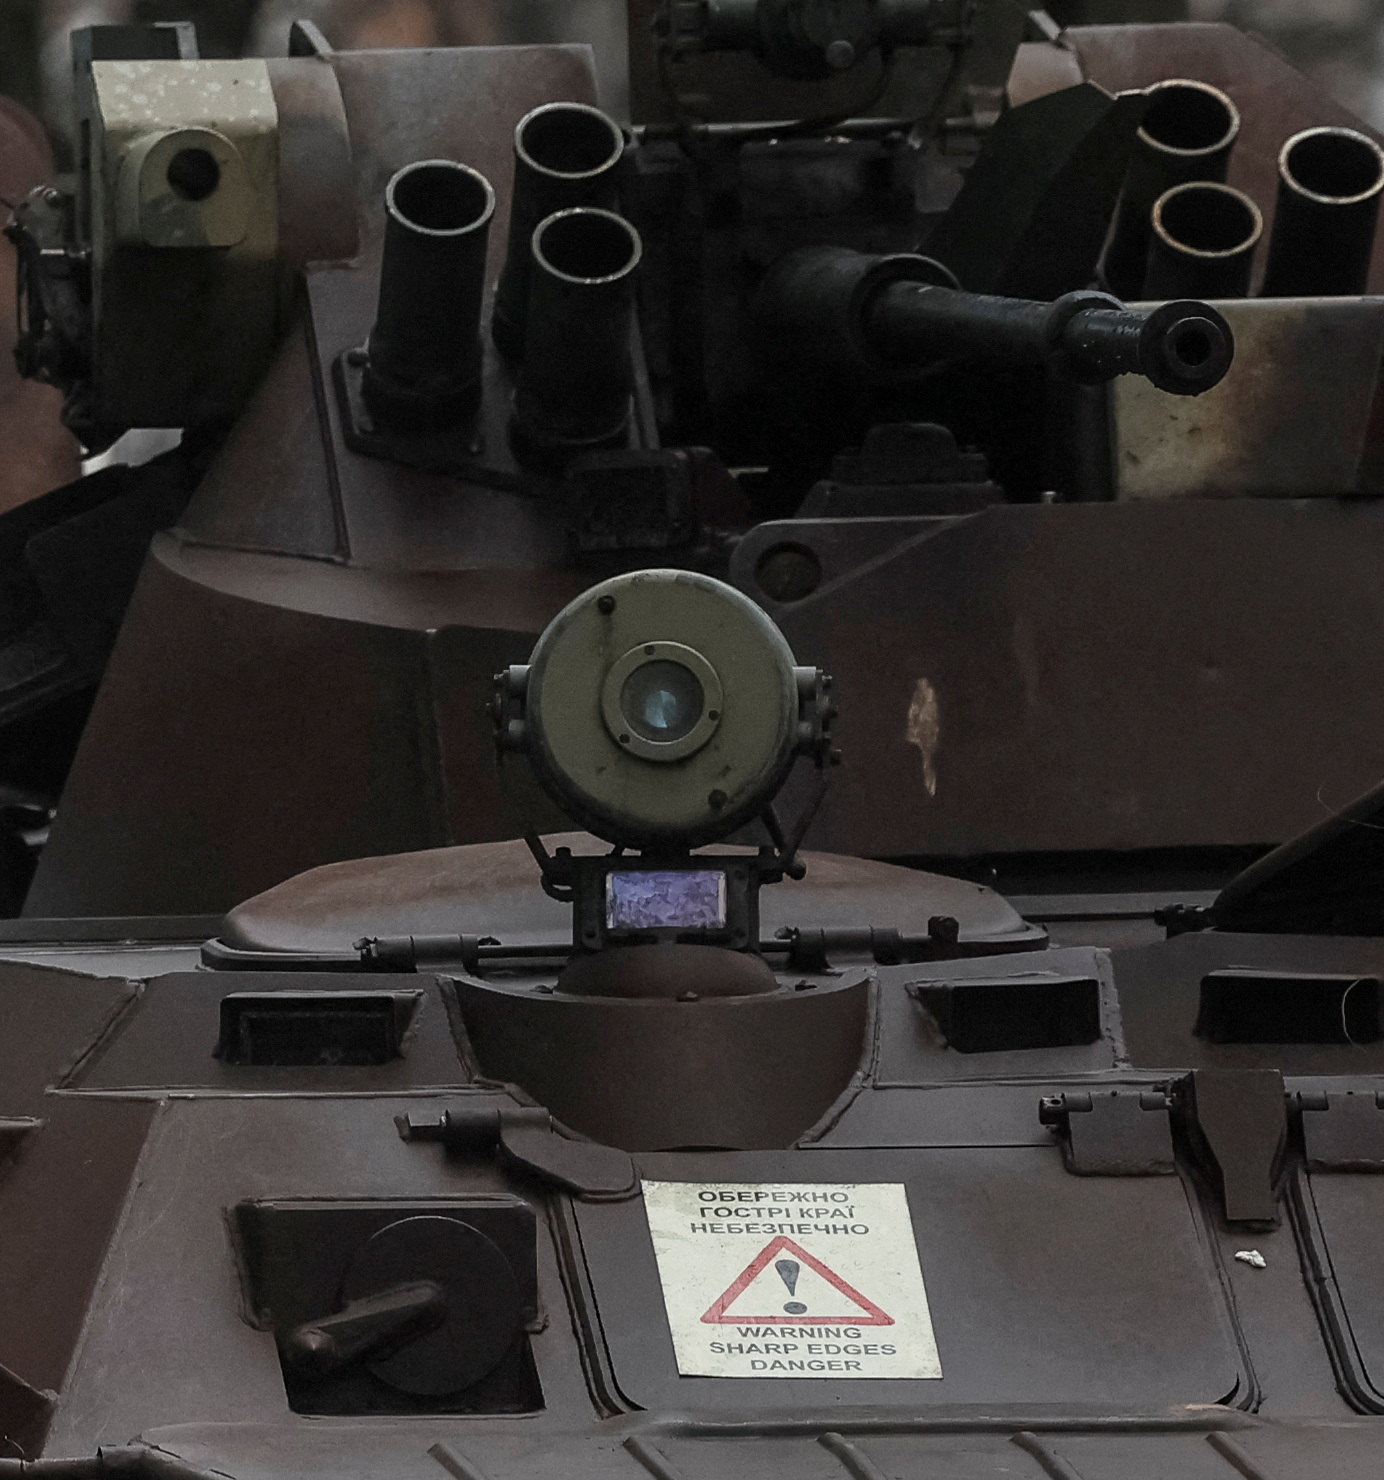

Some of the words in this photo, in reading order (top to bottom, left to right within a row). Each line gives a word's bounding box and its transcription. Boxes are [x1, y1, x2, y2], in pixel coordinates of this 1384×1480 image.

[697, 1190, 850, 1204] ОБЕРЕЖНО
[699, 1205, 792, 1219] ГОСТРІ
[798, 1204, 856, 1220] КРАЇ
[690, 1222, 870, 1236] НЕБЕЗПЕЧНО
[736, 1326, 862, 1340] WARNING
[709, 1341, 799, 1356] SHARP
[807, 1343, 898, 1356] EDGES
[750, 1359, 862, 1373] DANGER
